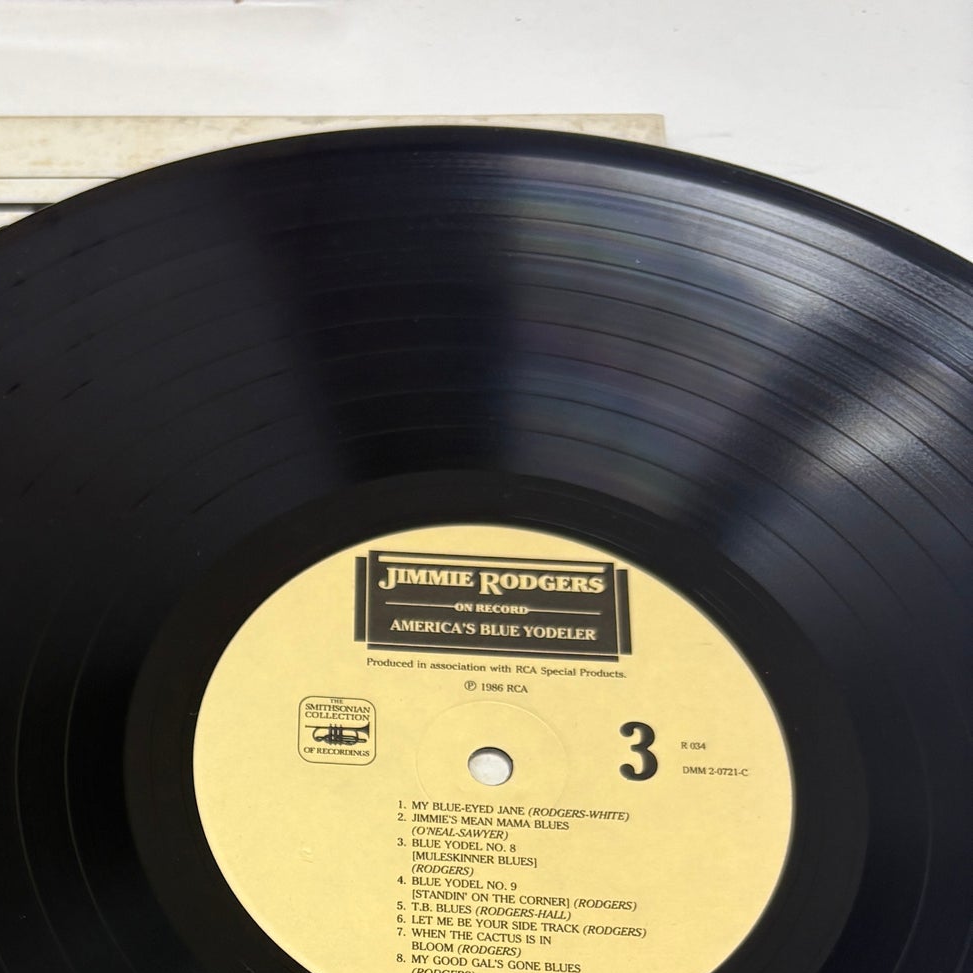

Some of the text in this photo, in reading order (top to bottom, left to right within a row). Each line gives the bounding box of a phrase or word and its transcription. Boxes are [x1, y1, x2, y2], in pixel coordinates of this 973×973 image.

[378, 567, 606, 596] JIMMIE RODGERS
[454, 603, 529, 615] ON RECORD
[390, 618, 597, 641] AMERICA'S BLUE YODELER
[367, 657, 627, 678] Produced in association with RCA Special Products.
[481, 683, 504, 692] 1986
[506, 684, 528, 693] RCA
[305, 703, 371, 713] SMITHSONIAN
[305, 711, 370, 721] COLLECTION
[316, 748, 370, 757] RECORDINGS
[619, 721, 659, 781] 3
[680, 741, 707, 750] R 034
[682, 766, 749, 777] DMM 2-0721-C
[398, 800, 630, 823] 1. MY BLUE-EYED JANE (RODGERS-WHITE)
[411, 826, 509, 841] (O'NEAL-SAWYER)
[397, 837, 517, 853] 3. BLUE YODEL NO. 8
[412, 851, 537, 869] [MULESKINNER BLUES]
[411, 864, 474, 877] (RODGERS)
[397, 875, 517, 891] 4. BLUE YODEL NO. 9
[412, 889, 637, 912] [STANDIN' ON THE CORNER] (RODGERS)
[396, 901, 571, 922] 5. T.B. BLUES (RODGERS-HALL)
[396, 914, 647, 939] 6. LET ME BE YOUR SIDE TRACK (RODGERS)
[397, 927, 551, 945] 7. WHEN THE CACTUS IS IN
[411, 941, 522, 958] BLOOM (RODGERS)
[396, 953, 581, 973] 8. MY GOOD GAL'S GONE BLUES
